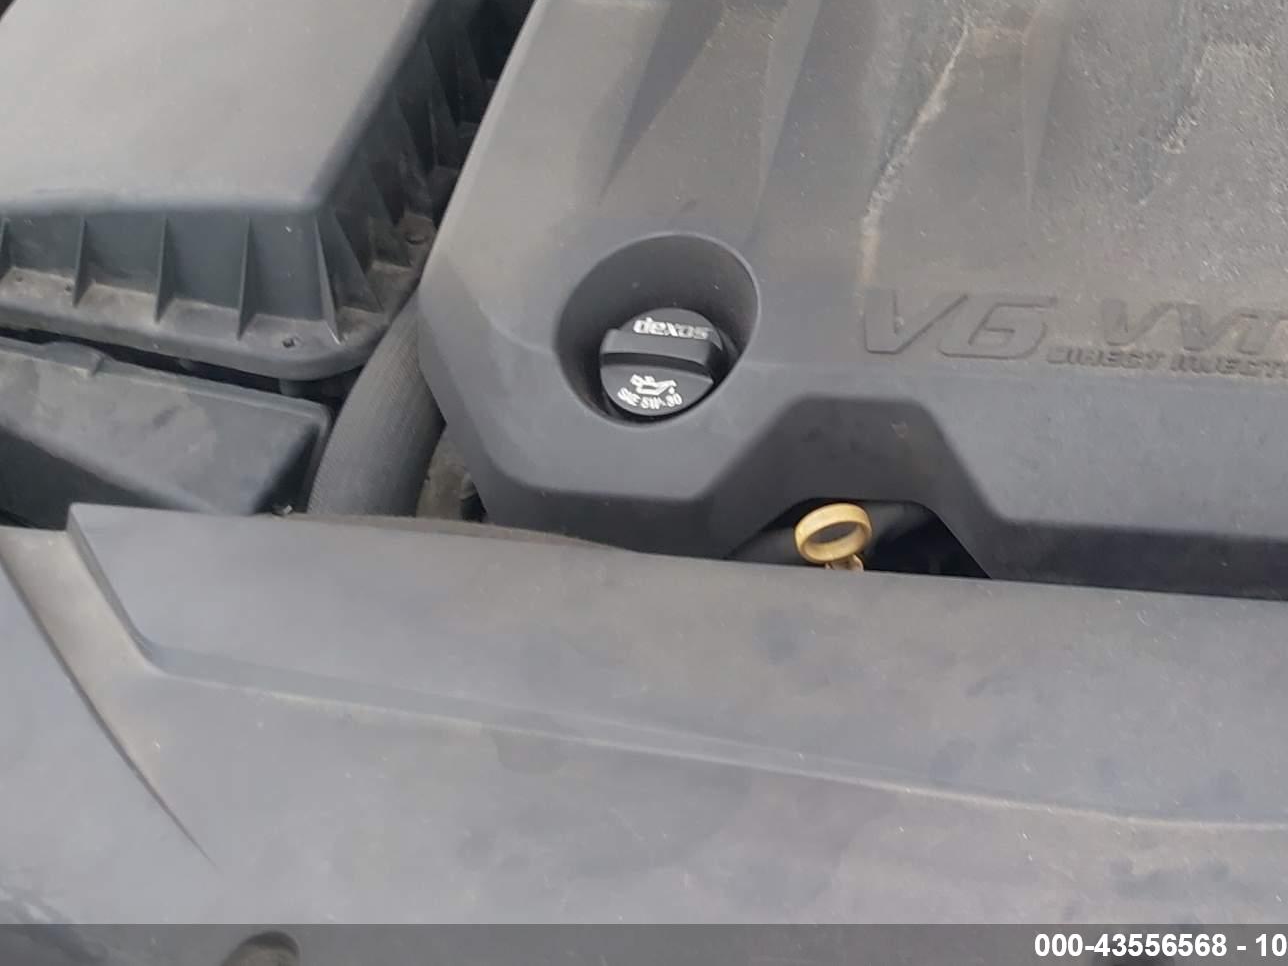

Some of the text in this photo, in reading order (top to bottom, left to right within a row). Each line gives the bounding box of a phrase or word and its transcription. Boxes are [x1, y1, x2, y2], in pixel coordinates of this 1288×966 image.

[633, 317, 709, 340] dexos
[863, 288, 1058, 361] V6
[1047, 345, 1166, 371] DIRECT
